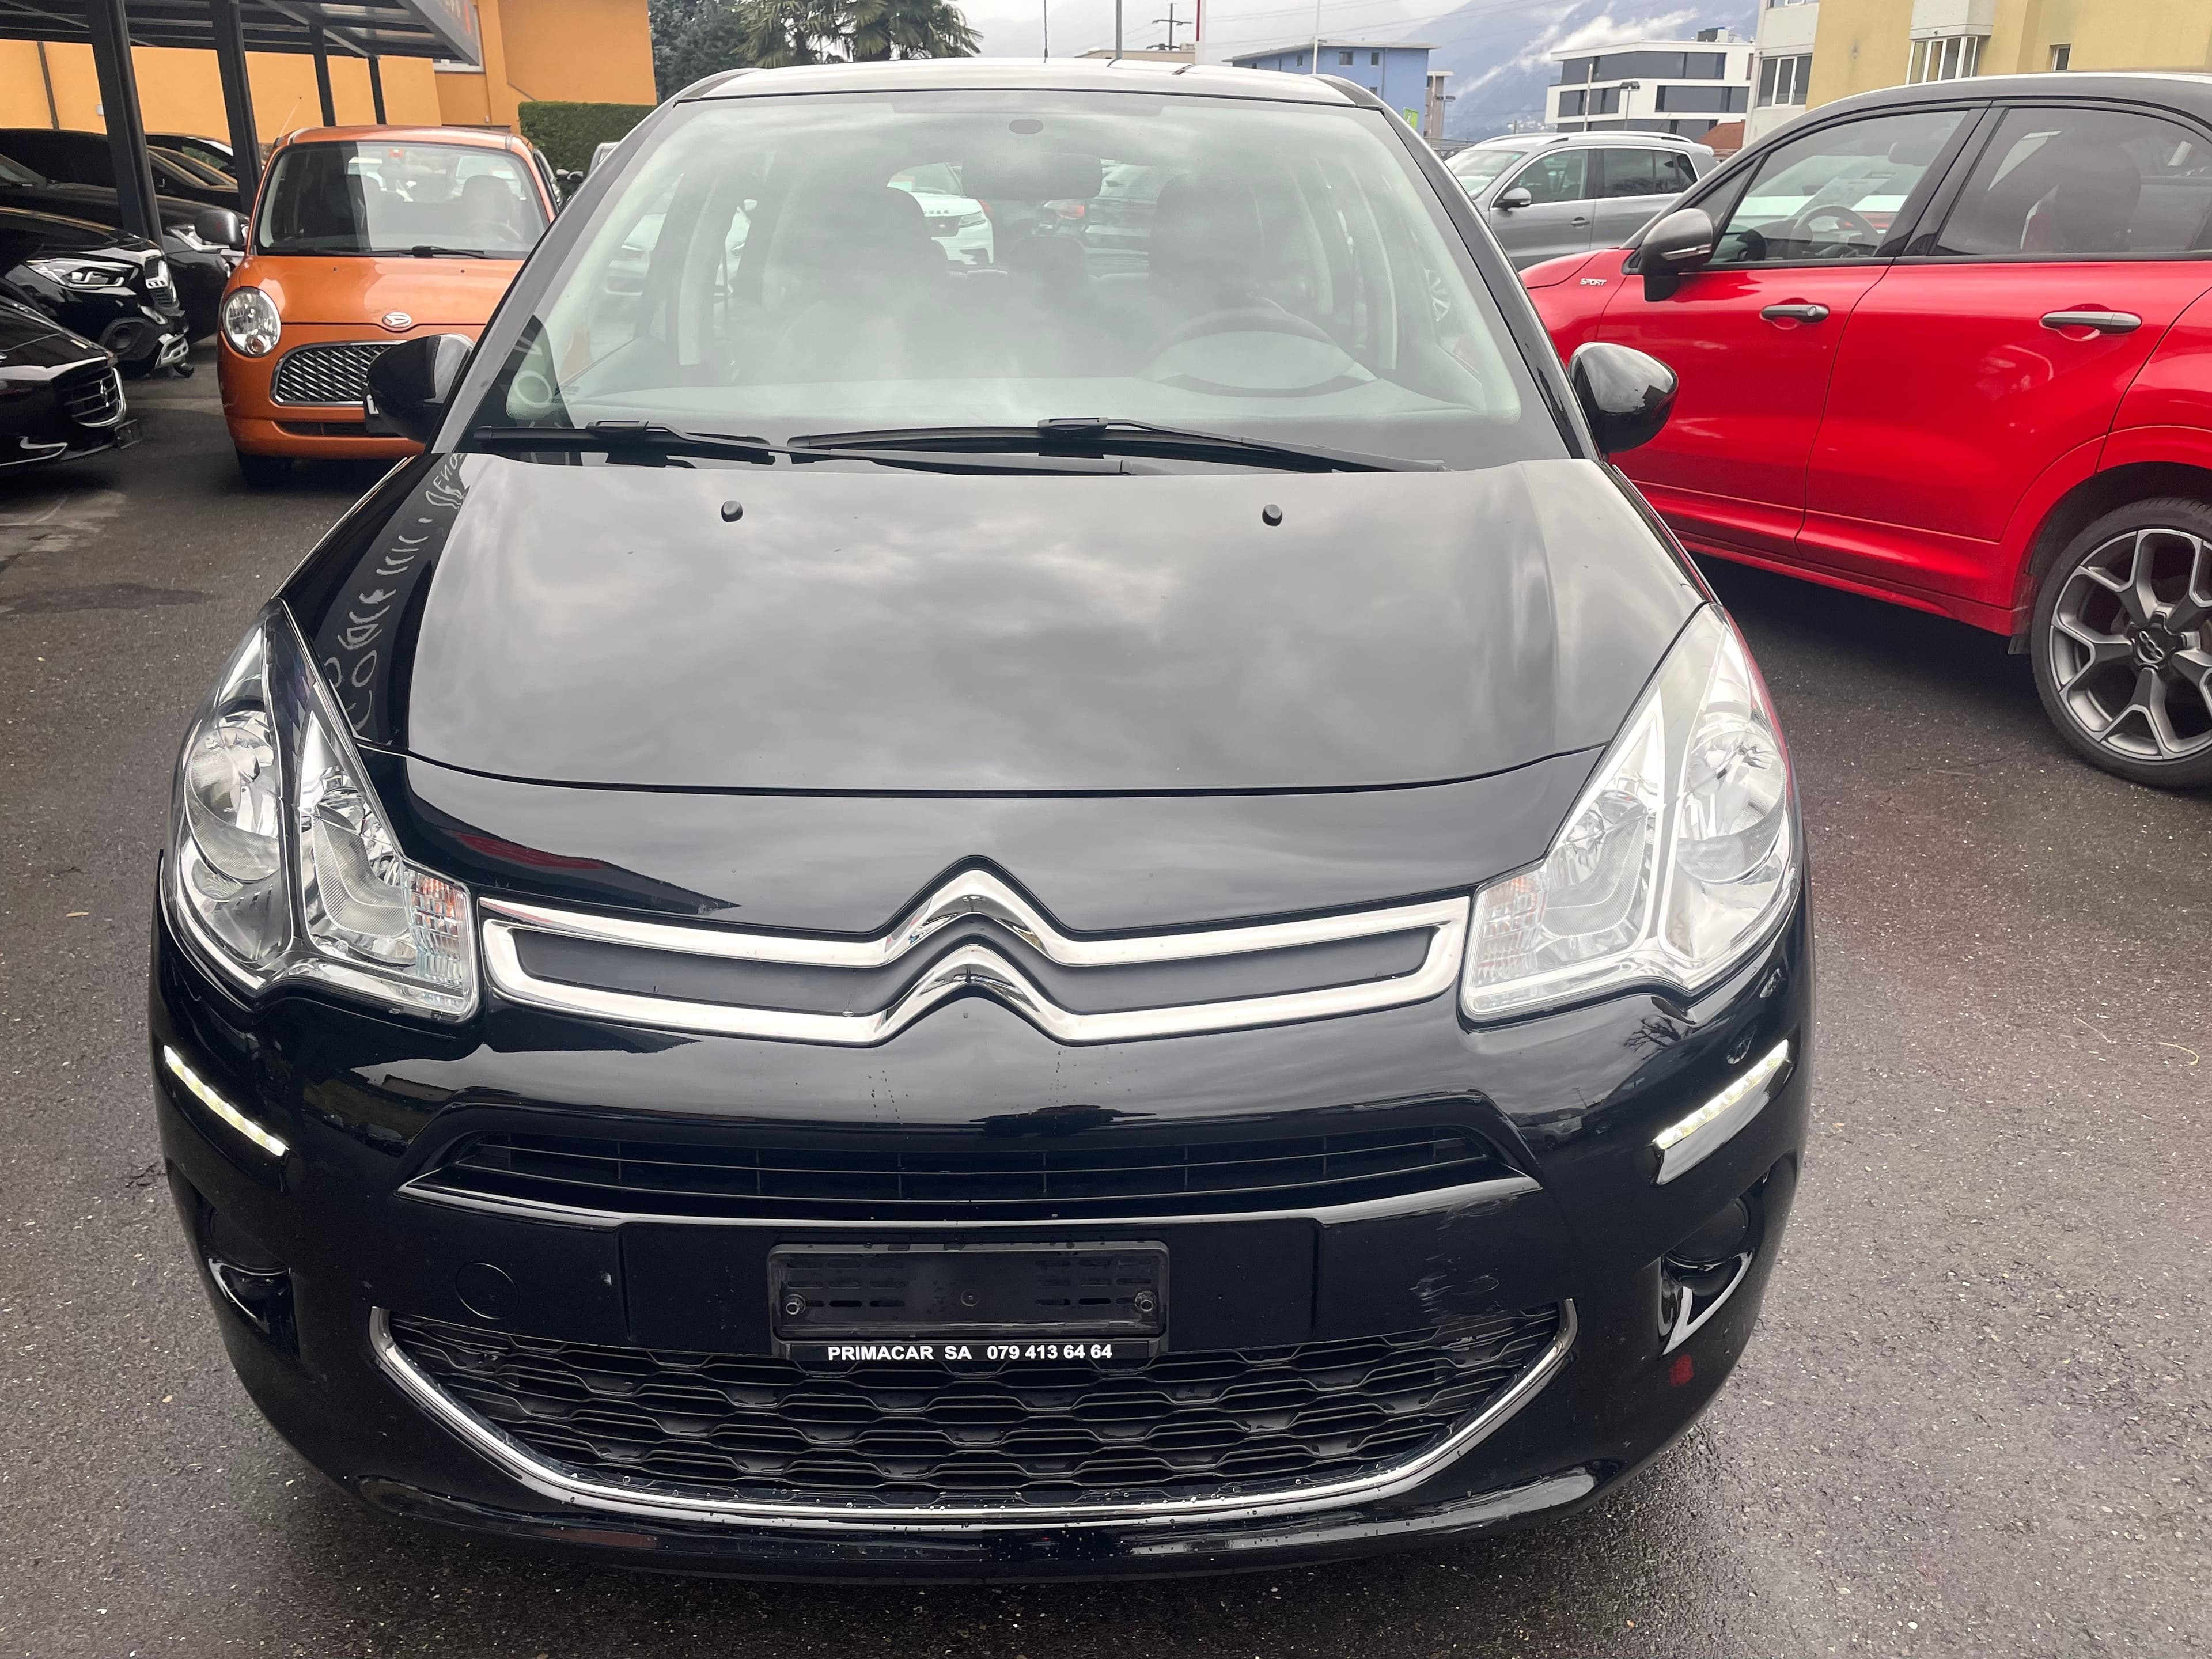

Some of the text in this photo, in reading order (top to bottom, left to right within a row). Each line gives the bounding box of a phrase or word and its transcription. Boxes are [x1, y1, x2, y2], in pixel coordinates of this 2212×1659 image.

[828, 1344, 1113, 1361] PRIMACAR SA 079 413 64 64
